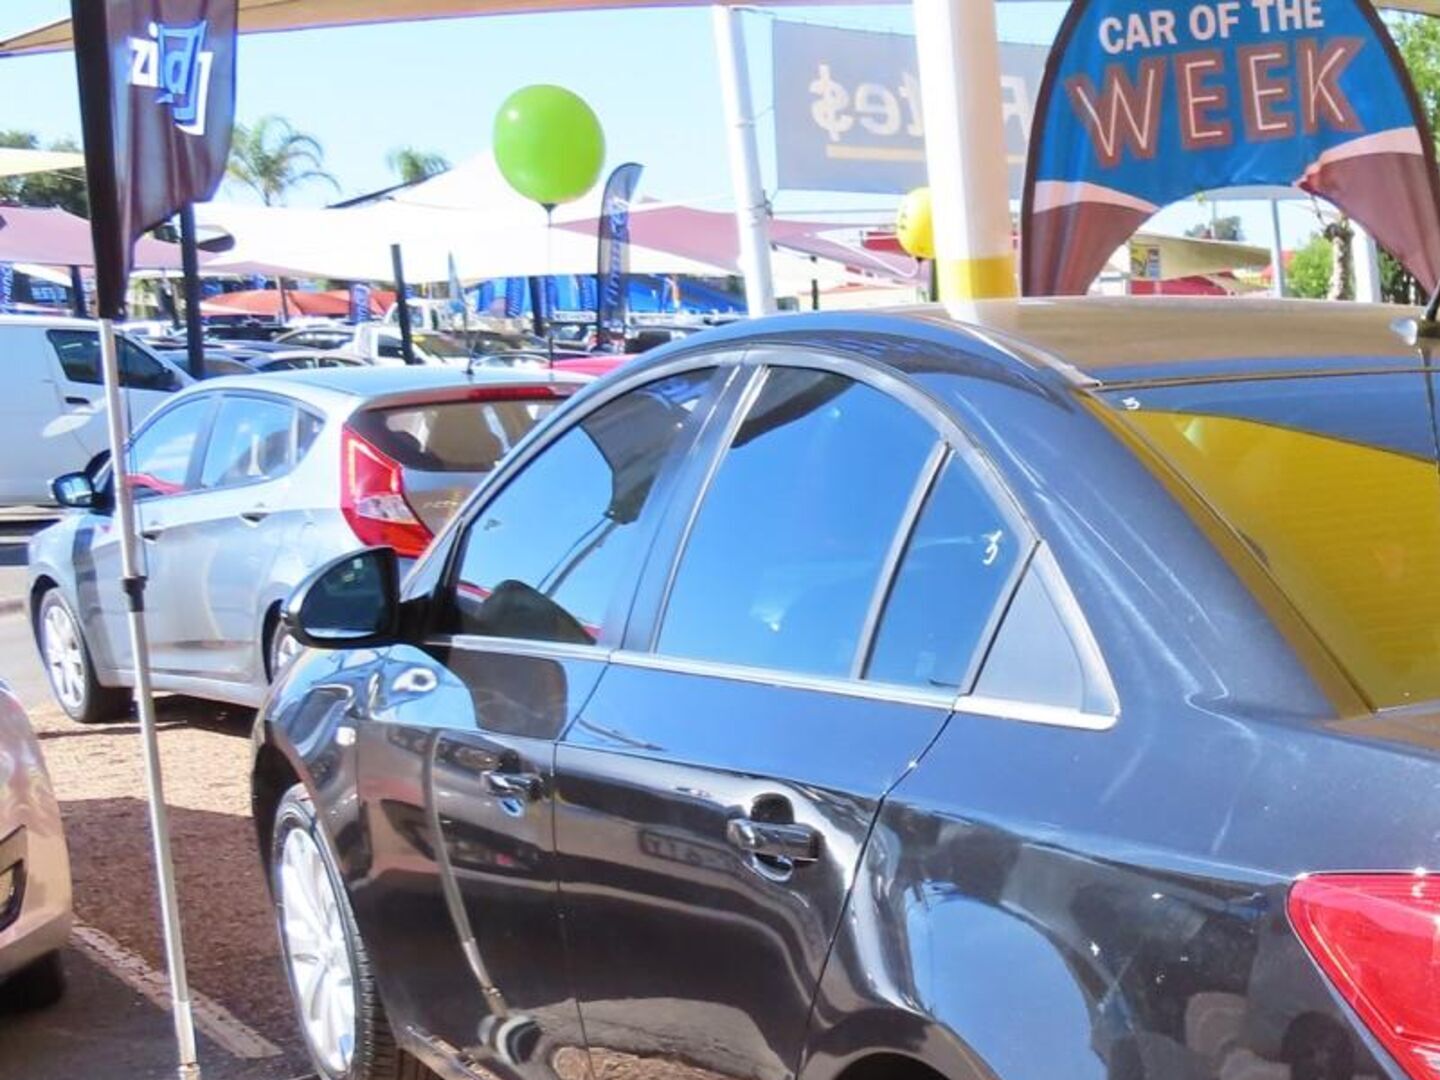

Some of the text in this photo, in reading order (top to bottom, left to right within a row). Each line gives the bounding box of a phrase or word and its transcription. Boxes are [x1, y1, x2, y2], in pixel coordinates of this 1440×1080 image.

[1098, 0, 1325, 54] CAR OF THE
[1064, 34, 1367, 170] WEEK
